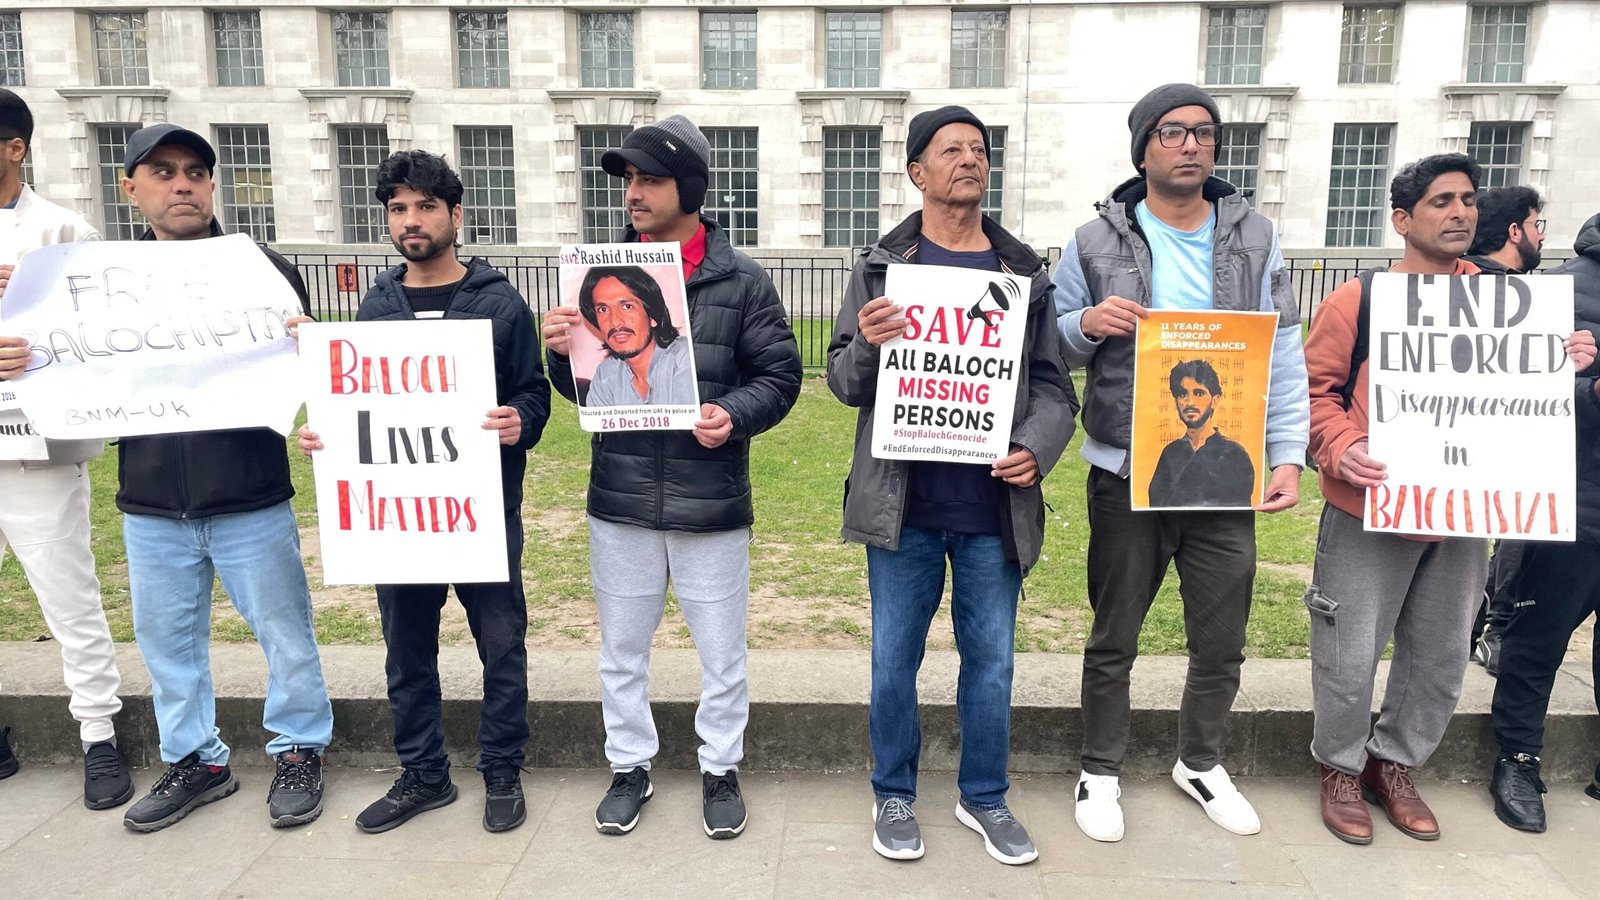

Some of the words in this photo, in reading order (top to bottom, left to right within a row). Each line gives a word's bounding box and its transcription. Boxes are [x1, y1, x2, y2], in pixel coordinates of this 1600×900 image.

[561, 253, 579, 264] SAVE
[580, 249, 622, 264] Rashid
[625, 248, 675, 264] Hussain
[66, 265, 208, 311] FRE
[1406, 274, 1532, 328] END
[902, 304, 1004, 348] SAVE
[1161, 323, 1170, 331] 11
[1173, 322, 1206, 331] YEARS
[1208, 323, 1223, 332] OF
[1161, 332, 1211, 340] ENFORCED
[1161, 341, 1247, 350] DISAPPEARANCES
[1380, 331, 1567, 374] ENFORCED
[329, 339, 457, 395] BALOCH
[923, 351, 1014, 381] BALOCH
[898, 376, 990, 405] MISSING
[614, 408, 638, 416] Deported
[893, 404, 995, 432] PERSONS
[1375, 384, 1571, 428] Disappearances
[601, 418, 616, 429] 26
[620, 417, 639, 428] Dec
[642, 416, 670, 427] 2018
[893, 428, 987, 444] #StopBalochGenocide
[357, 410, 459, 465] LIVES
[883, 443, 998, 460] #EndEnforcedDisappearances
[1443, 441, 1473, 466] in
[337, 479, 477, 533] MATTERS
